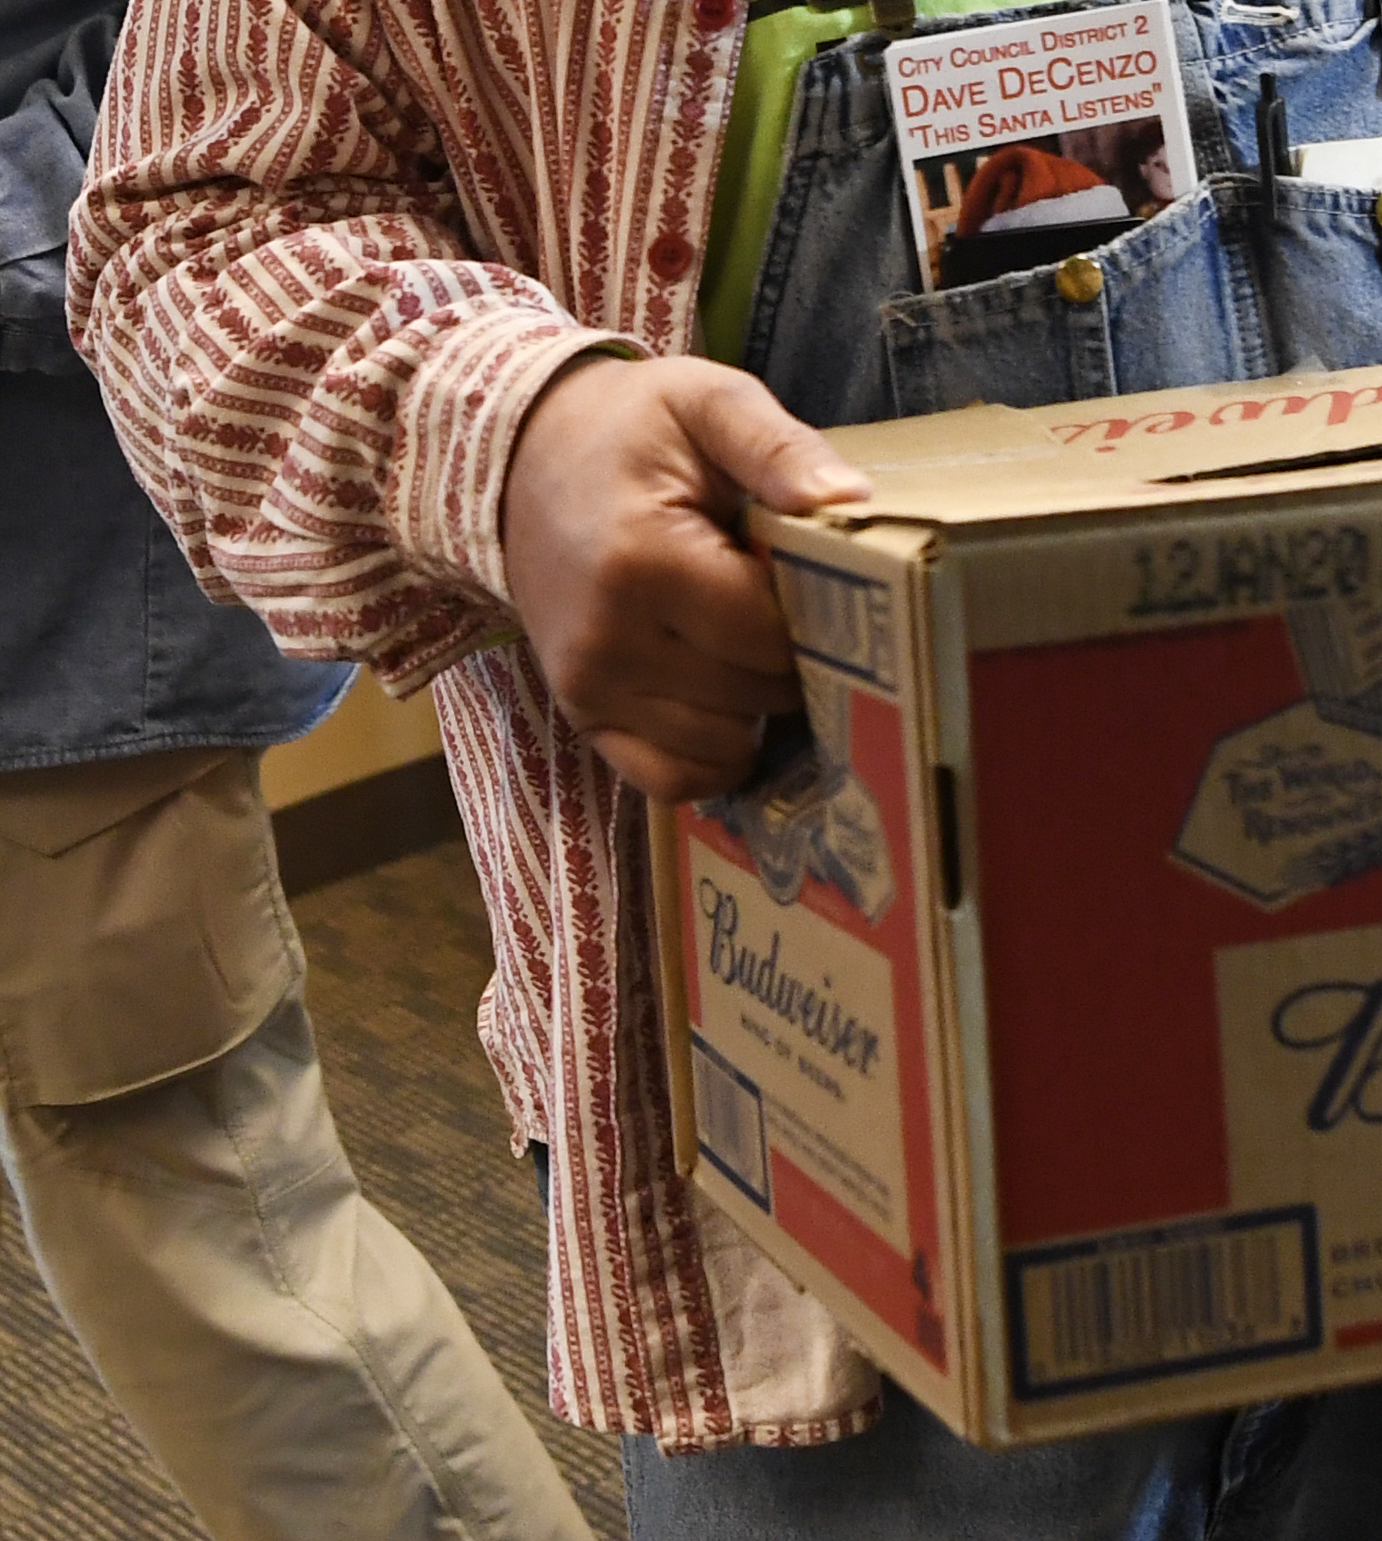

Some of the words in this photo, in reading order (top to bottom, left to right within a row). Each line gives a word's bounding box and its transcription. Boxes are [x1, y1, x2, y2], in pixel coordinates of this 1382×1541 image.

[898, 56, 943, 78] CITY
[950, 41, 1035, 68] COUNCIL
[1041, 23, 1127, 52] DISTRICT
[1134, 15, 1149, 35] 2
[901, 81, 988, 118] DAVE
[978, 109, 1054, 138] SANTA
[699, 877, 881, 1077] Budweiser
